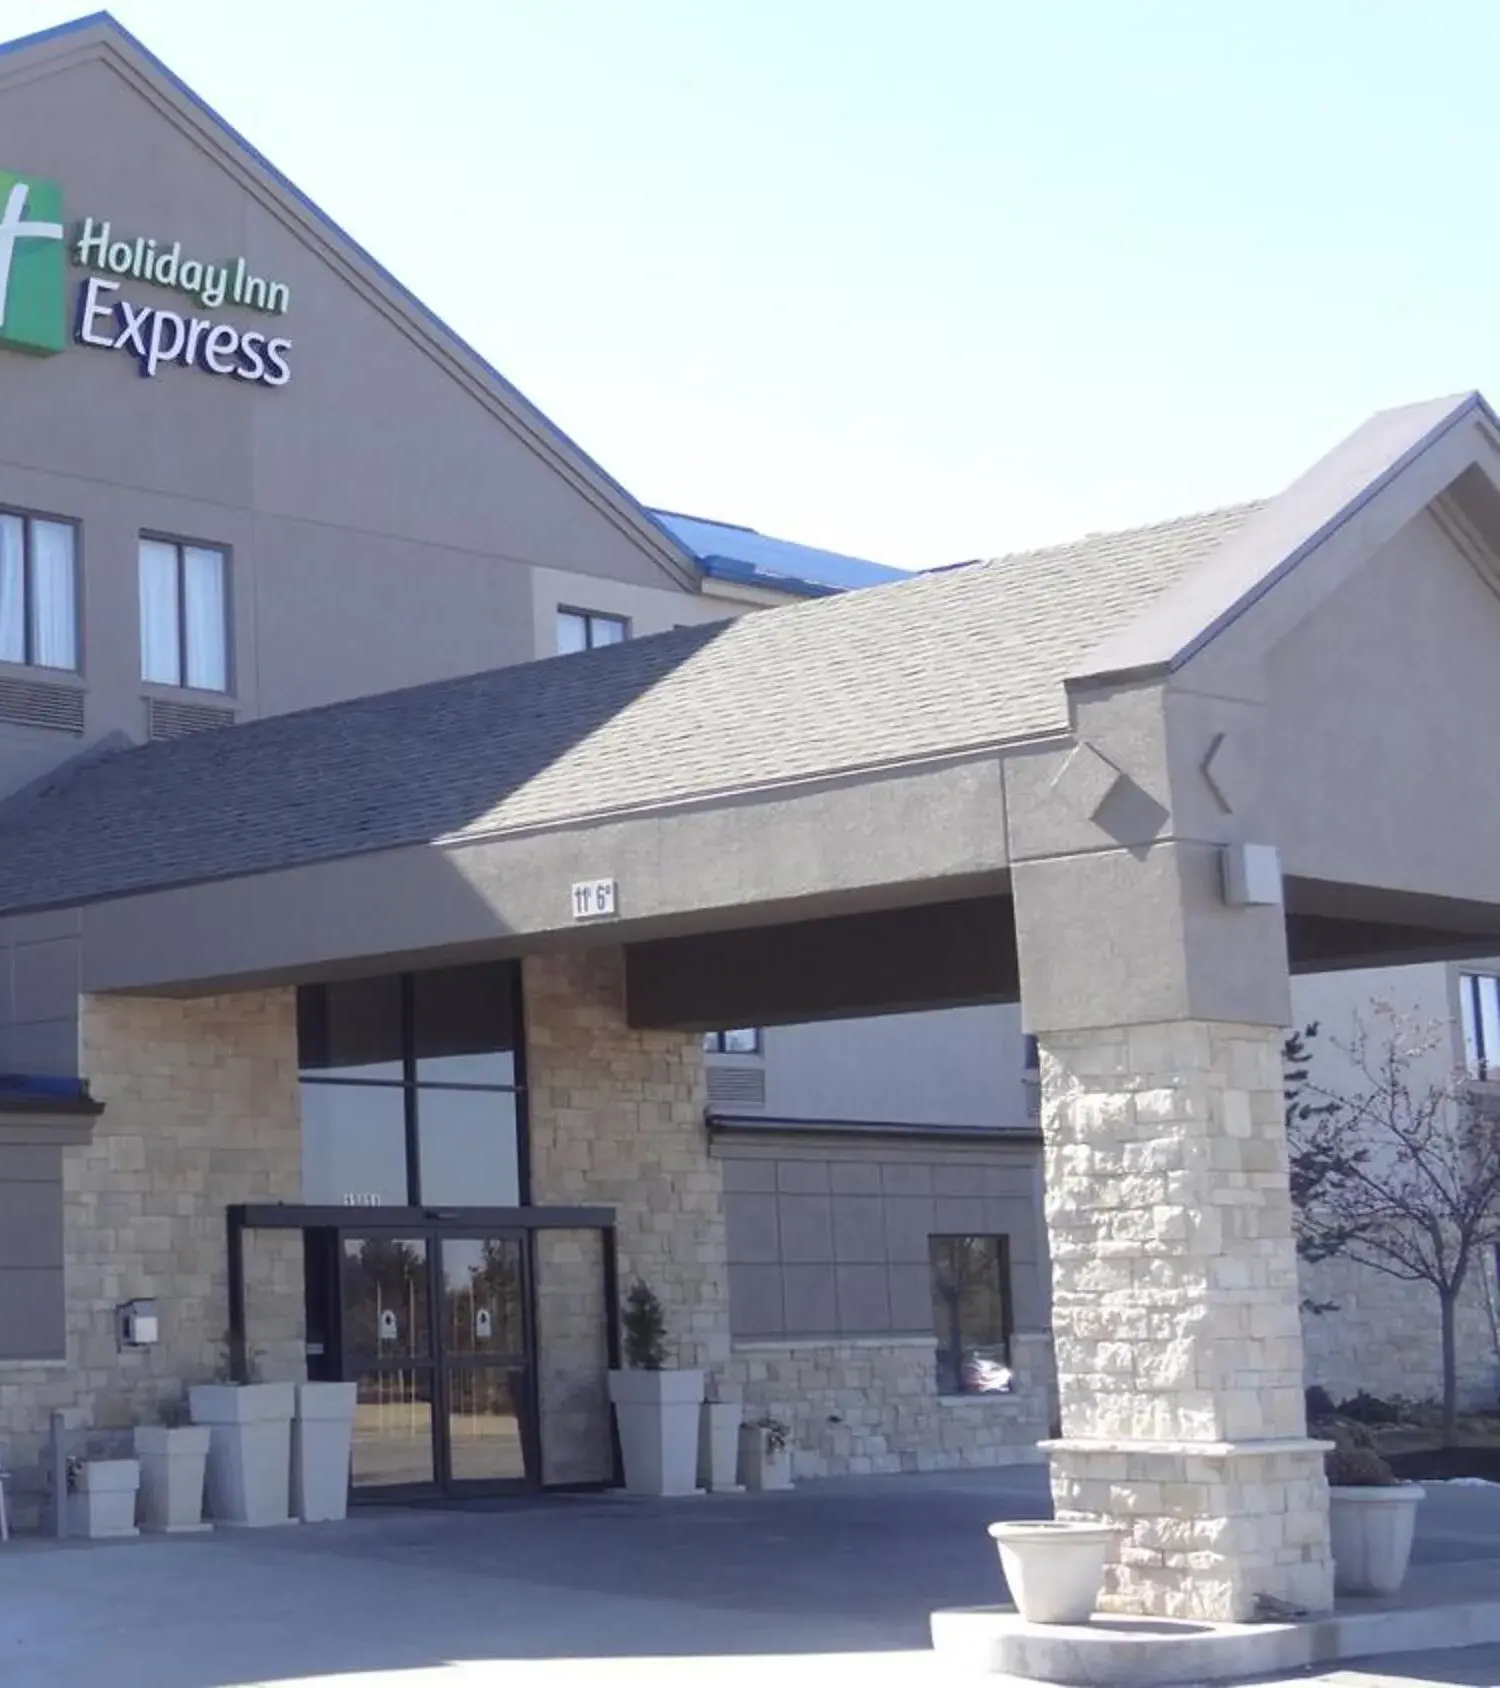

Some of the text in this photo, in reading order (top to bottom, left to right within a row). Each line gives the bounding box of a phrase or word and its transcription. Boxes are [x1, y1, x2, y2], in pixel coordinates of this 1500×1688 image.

[77, 217, 291, 314] Holiday Inn
[81, 276, 293, 387] Express
